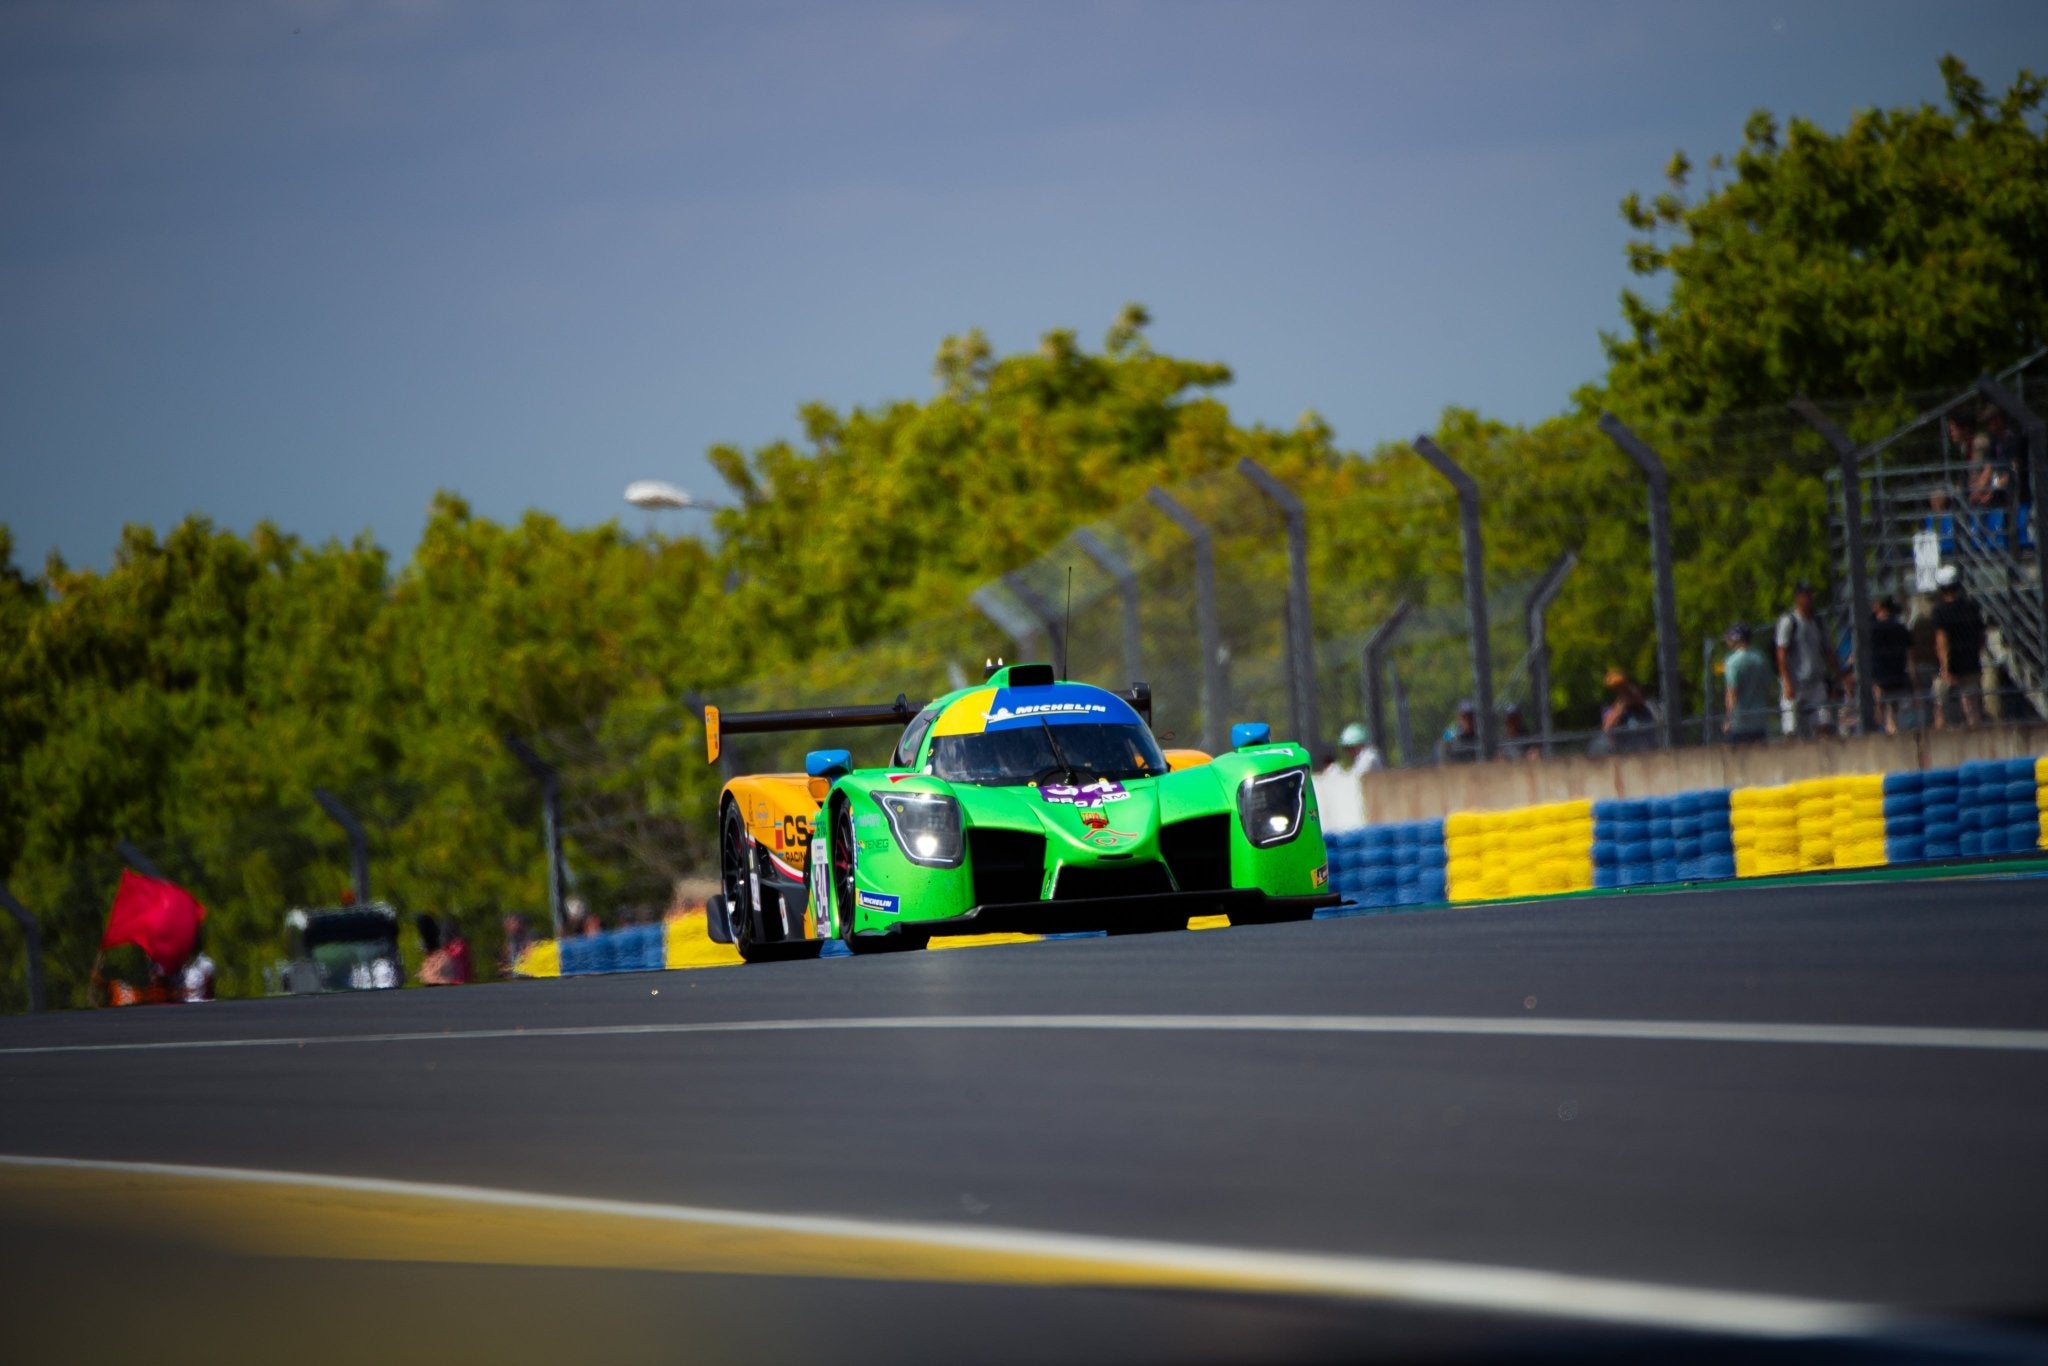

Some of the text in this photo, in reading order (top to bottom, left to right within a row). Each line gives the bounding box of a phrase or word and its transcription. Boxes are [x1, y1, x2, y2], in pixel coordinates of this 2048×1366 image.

[1015, 703, 1106, 714] MICHELIN
[783, 814, 809, 847] CS
[863, 896, 892, 908] MICHELIN
